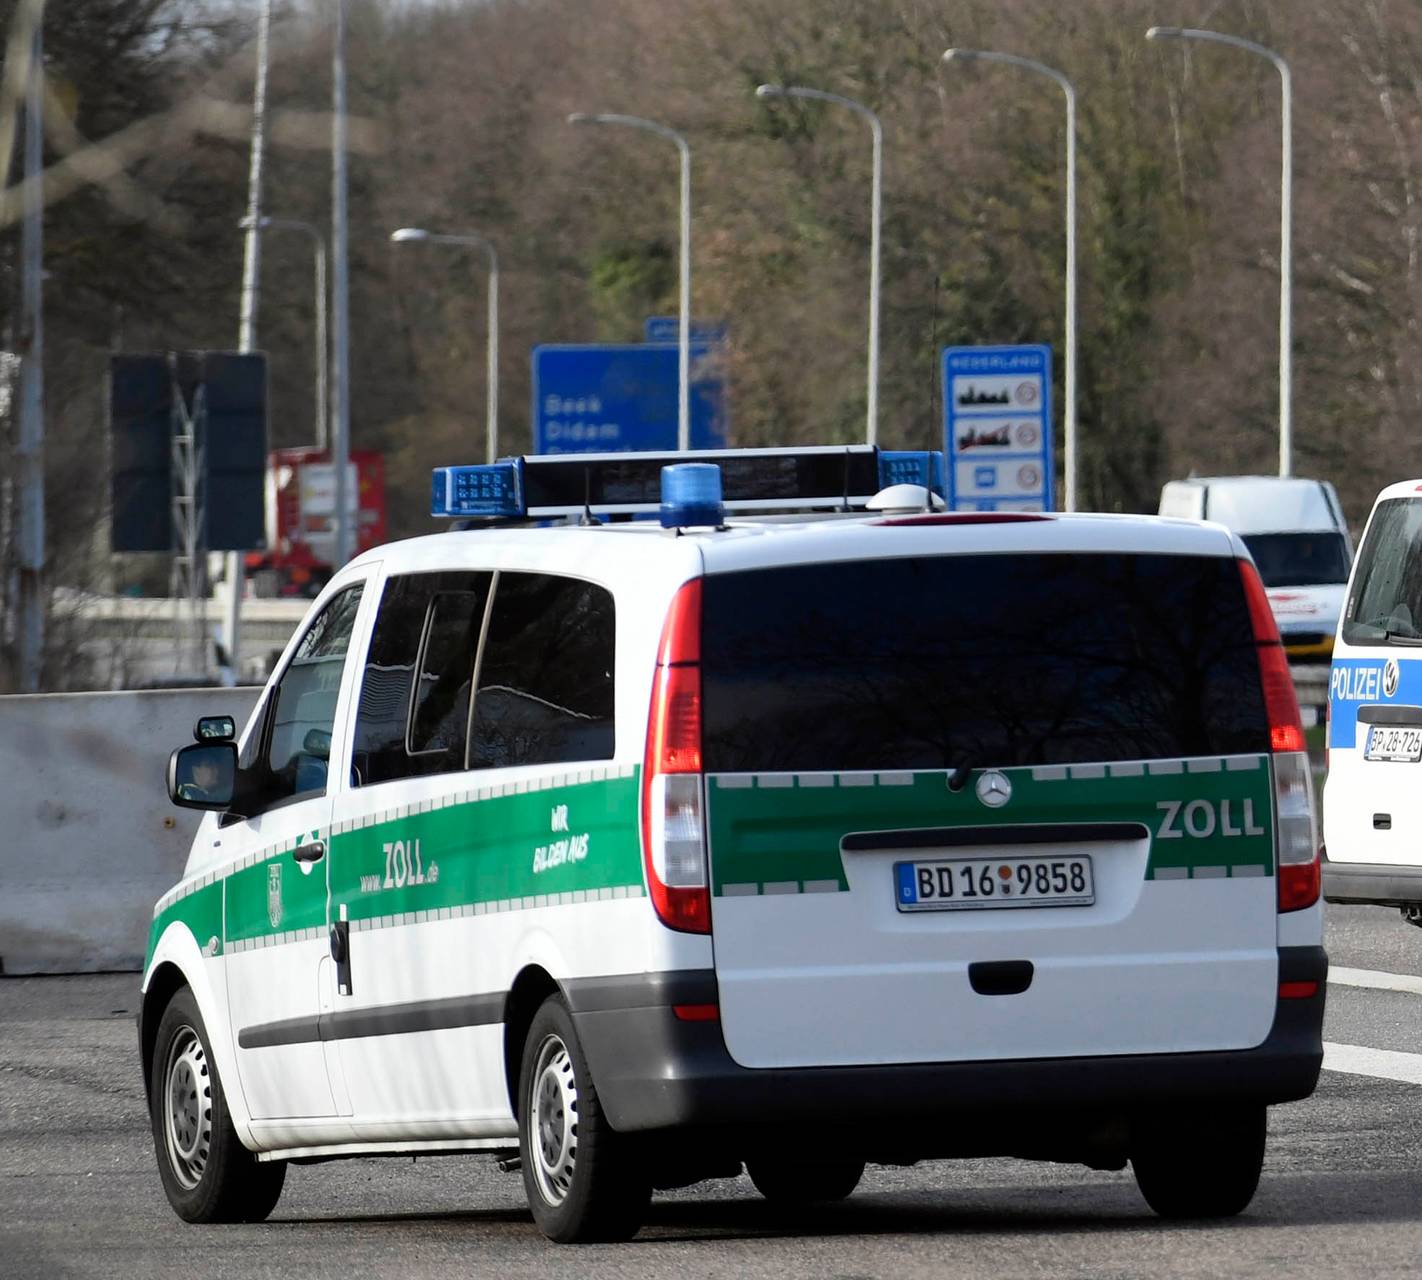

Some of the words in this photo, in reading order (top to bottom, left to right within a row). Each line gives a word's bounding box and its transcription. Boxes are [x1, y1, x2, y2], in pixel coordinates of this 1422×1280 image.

[545, 394, 601, 416] Beek
[545, 421, 619, 441] Didam
[1331, 667, 1381, 700] POLIZEI
[551, 804, 569, 832] WIR
[1156, 798, 1265, 840] ZOLL
[532, 839, 570, 874] BILDEN
[566, 832, 590, 865] AUS
[917, 867, 954, 899] BD
[960, 865, 995, 897] 16
[1016, 862, 1087, 895] 9858
